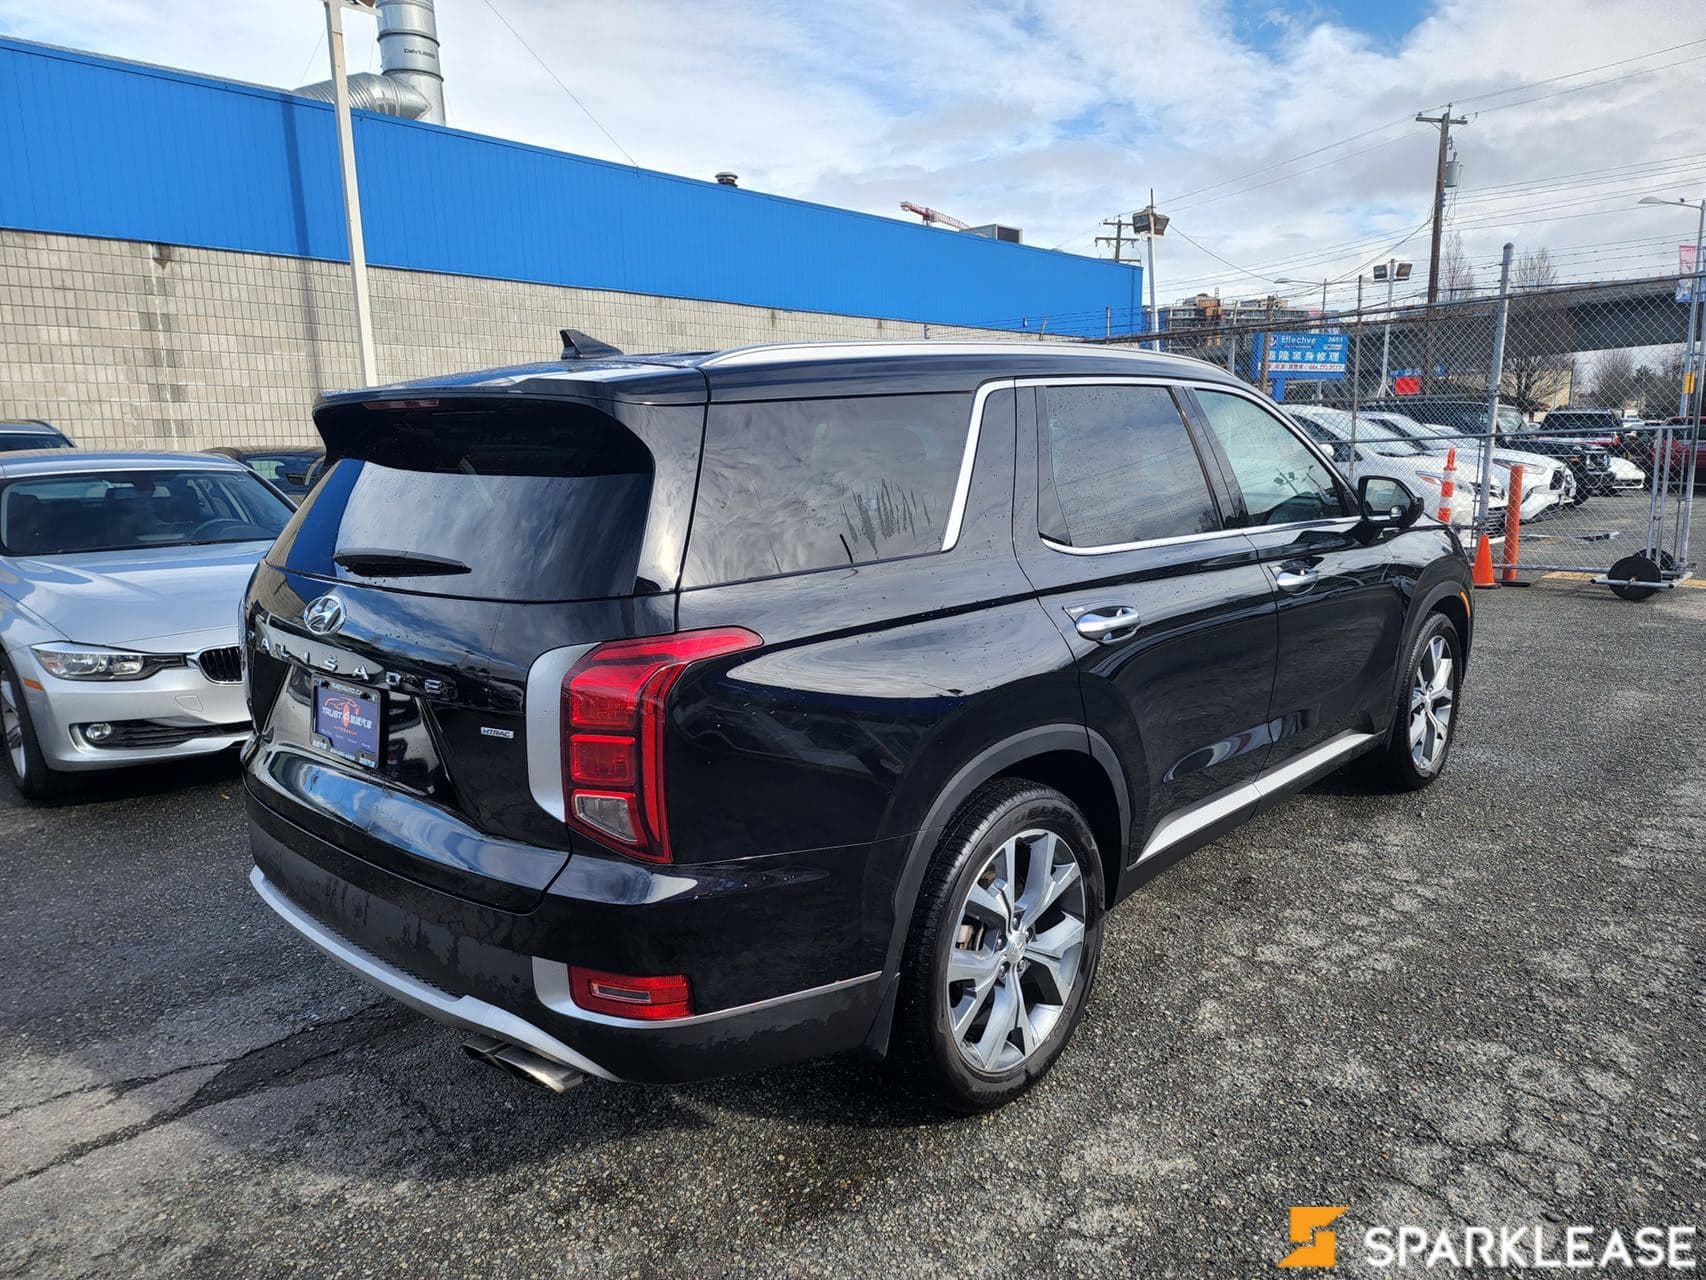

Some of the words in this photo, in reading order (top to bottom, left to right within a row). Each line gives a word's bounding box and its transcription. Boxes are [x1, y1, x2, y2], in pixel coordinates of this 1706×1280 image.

[248, 629, 442, 694] PALISADE
[322, 706, 343, 720] TRUST
[481, 727, 513, 738] HTRAC
